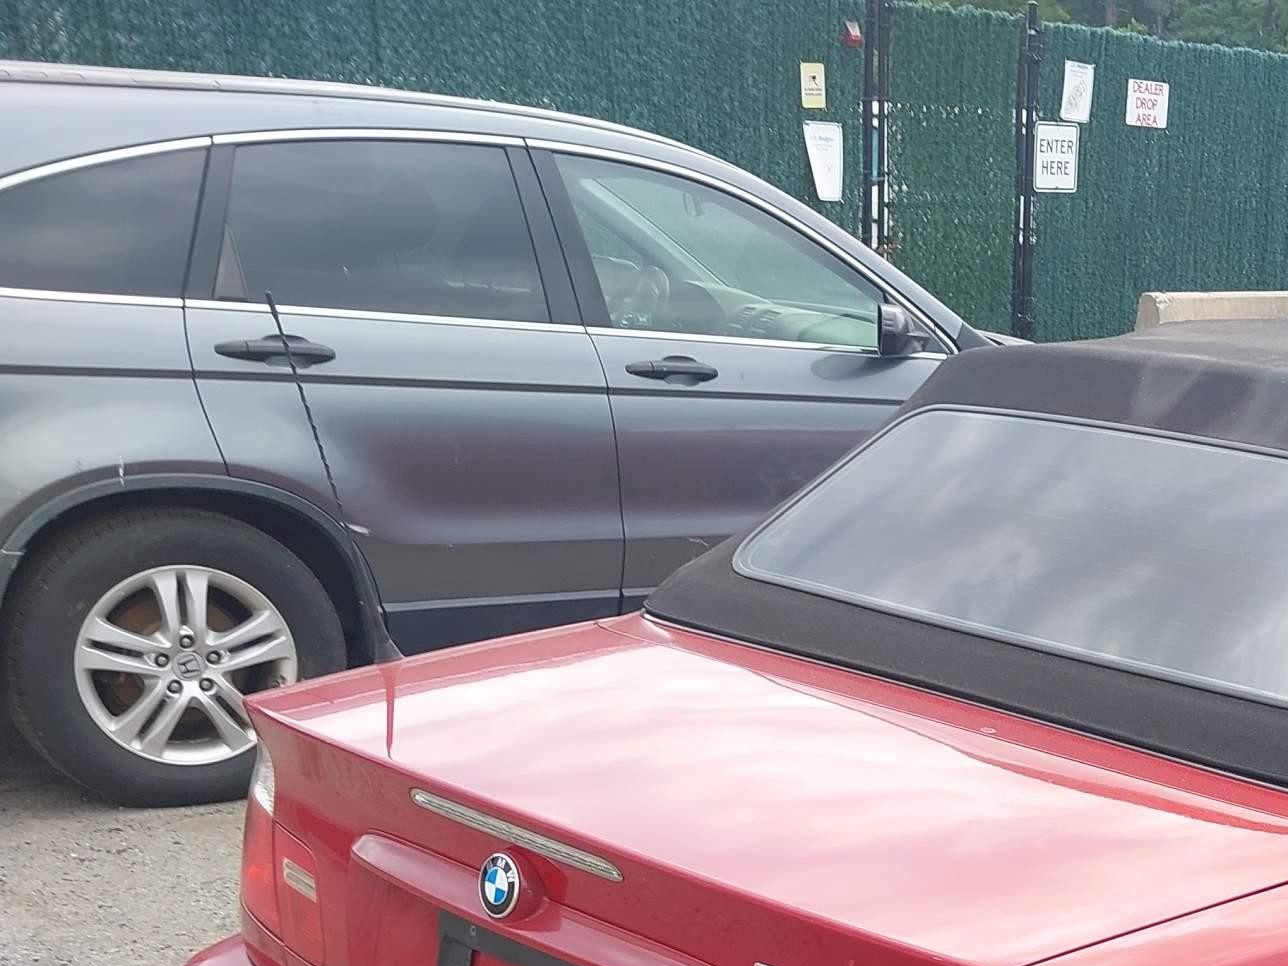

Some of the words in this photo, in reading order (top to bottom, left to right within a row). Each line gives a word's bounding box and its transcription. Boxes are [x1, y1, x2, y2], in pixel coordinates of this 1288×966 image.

[1133, 80, 1164, 96] DEALER
[1136, 97, 1159, 111] DROP
[1135, 114, 1158, 126] AREA
[1040, 138, 1074, 155] ENTER
[1042, 160, 1070, 176] HERE
